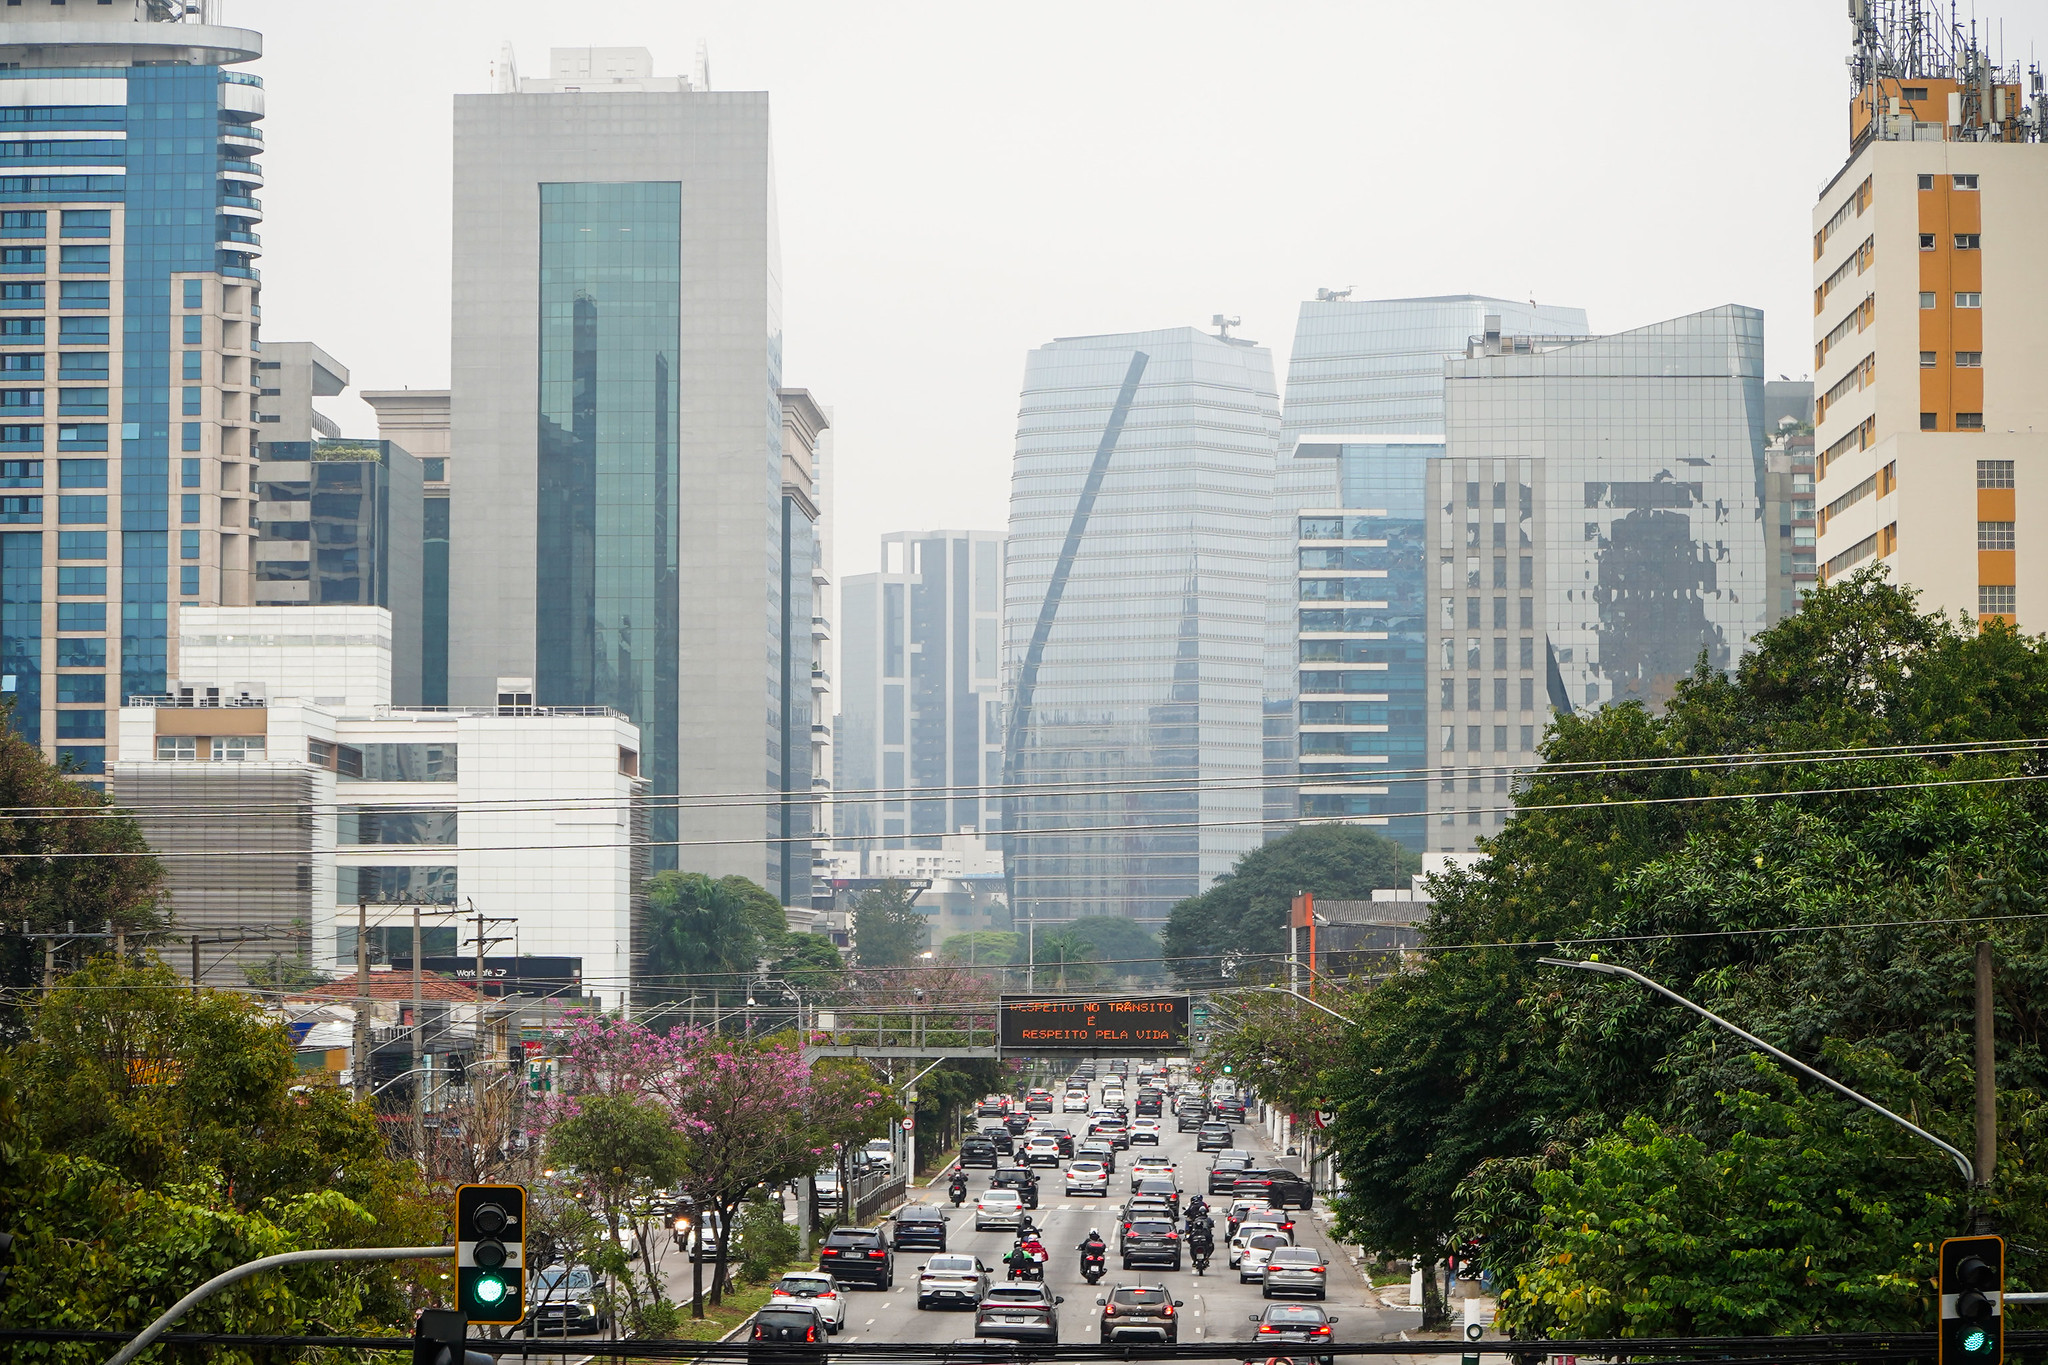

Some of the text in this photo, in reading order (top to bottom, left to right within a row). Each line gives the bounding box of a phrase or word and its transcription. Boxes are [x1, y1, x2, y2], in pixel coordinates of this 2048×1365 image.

[456, 969, 477, 977] Work
[1083, 1002, 1100, 1013] NO
[1087, 1015, 1096, 1026] É
[1022, 1029, 1169, 1040] RESPEITO PELA VIDA
